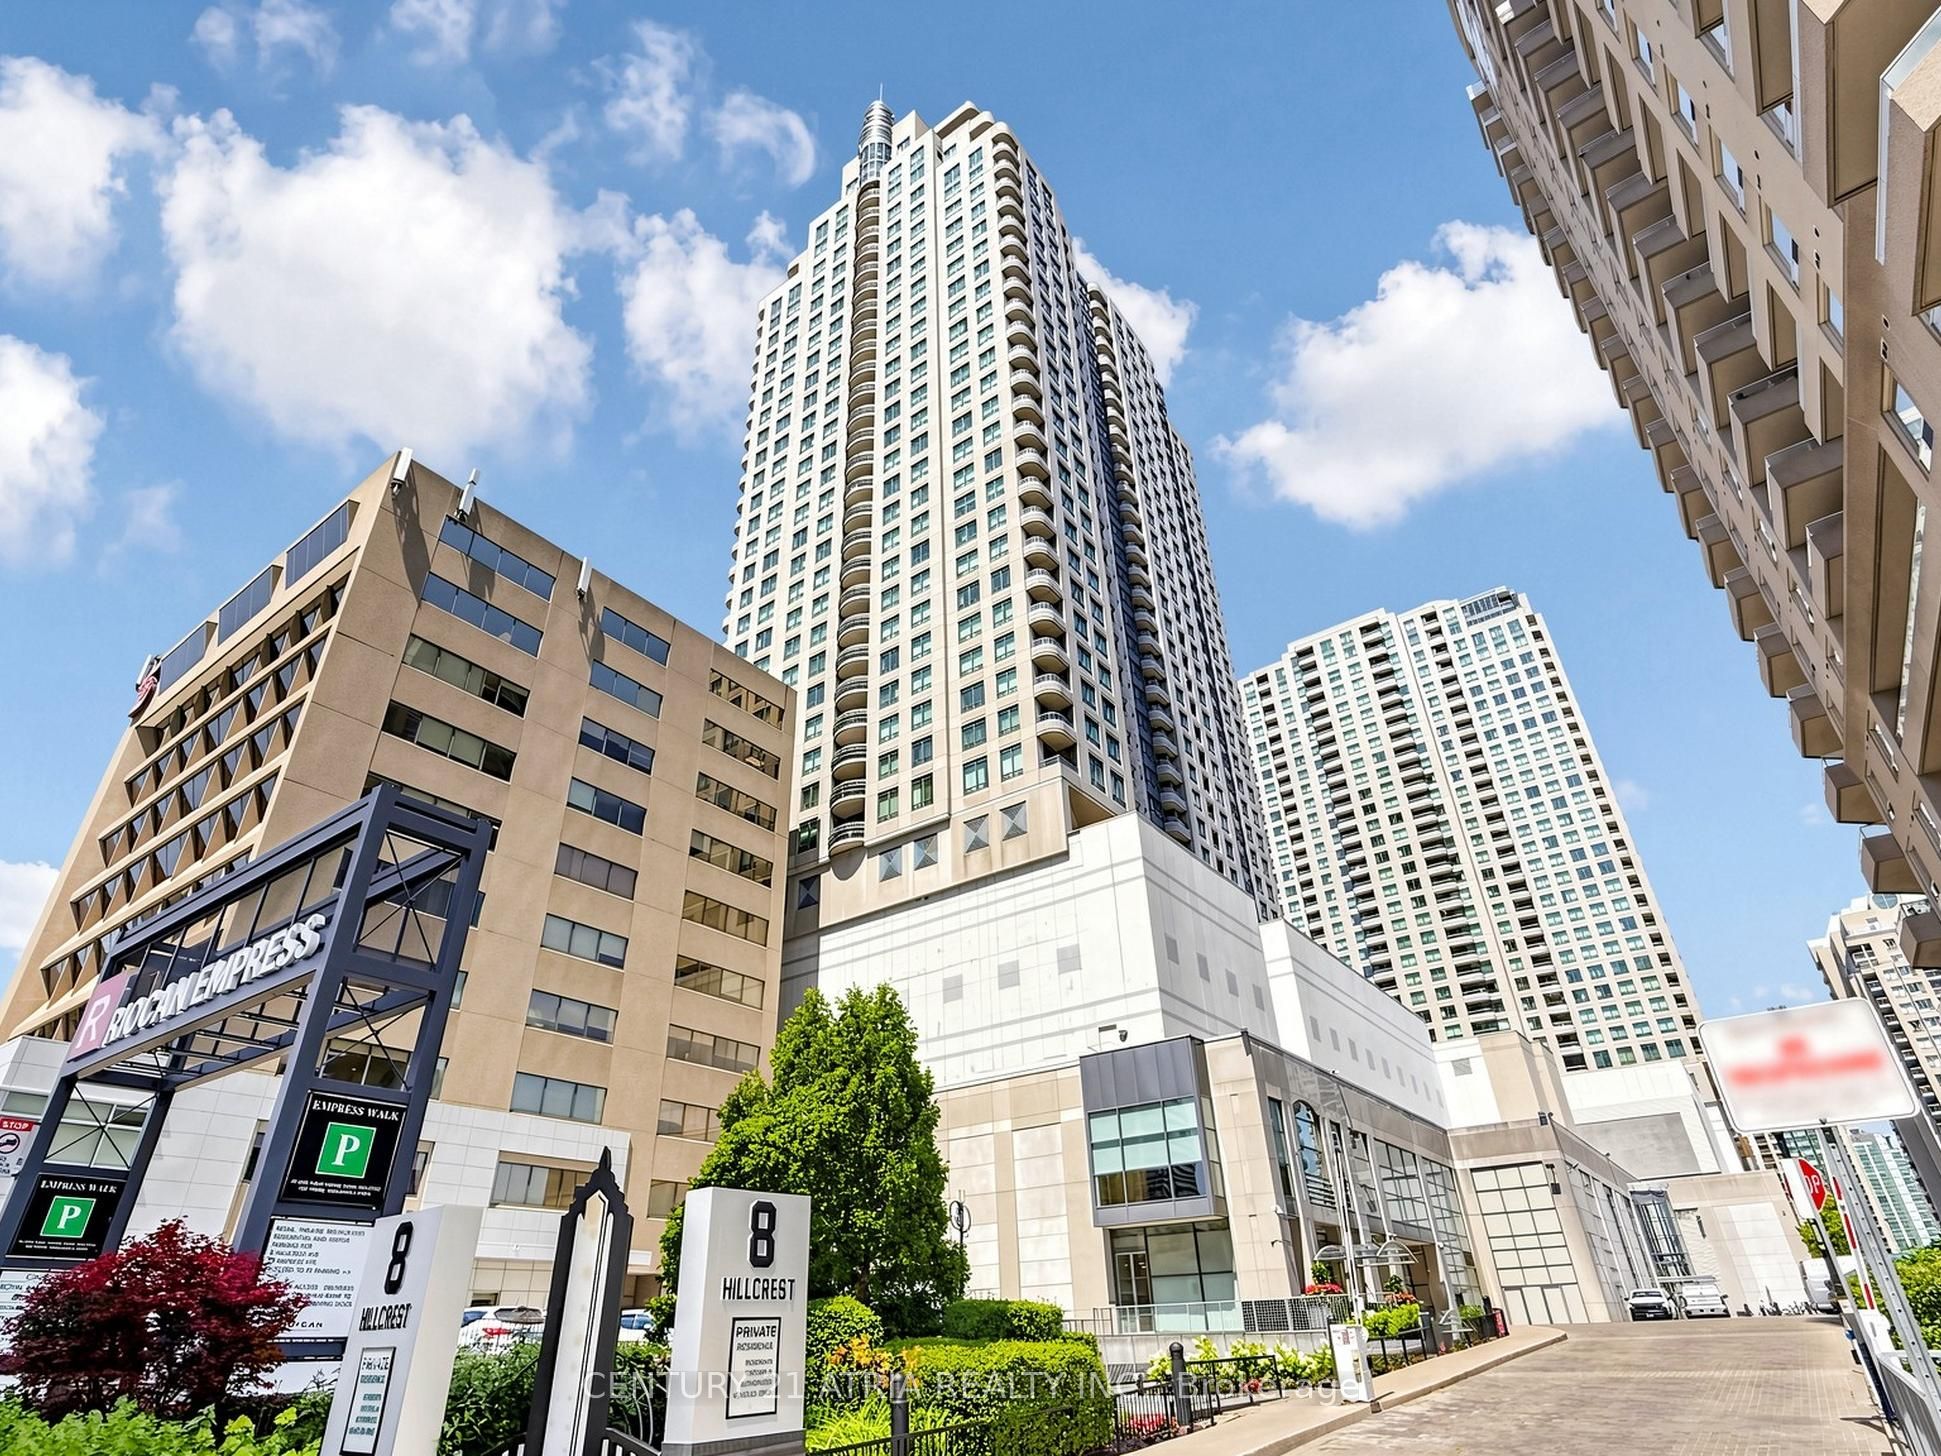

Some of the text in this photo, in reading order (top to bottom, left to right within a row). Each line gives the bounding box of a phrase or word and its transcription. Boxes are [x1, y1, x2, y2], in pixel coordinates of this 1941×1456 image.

[101, 913, 326, 1048] RIOCAN EMPRESS
[312, 1099, 399, 1121] EMPRESS WALK
[2, 1121, 30, 1130] STOP
[331, 1134, 360, 1166] P
[57, 1204, 82, 1230] P
[748, 1200, 777, 1268] 8
[384, 1221, 413, 1295] 8
[722, 1276, 795, 1300] HILLCREST
[359, 1303, 412, 1331] HILLCREST
[736, 1325, 776, 1337] PRIVATE
